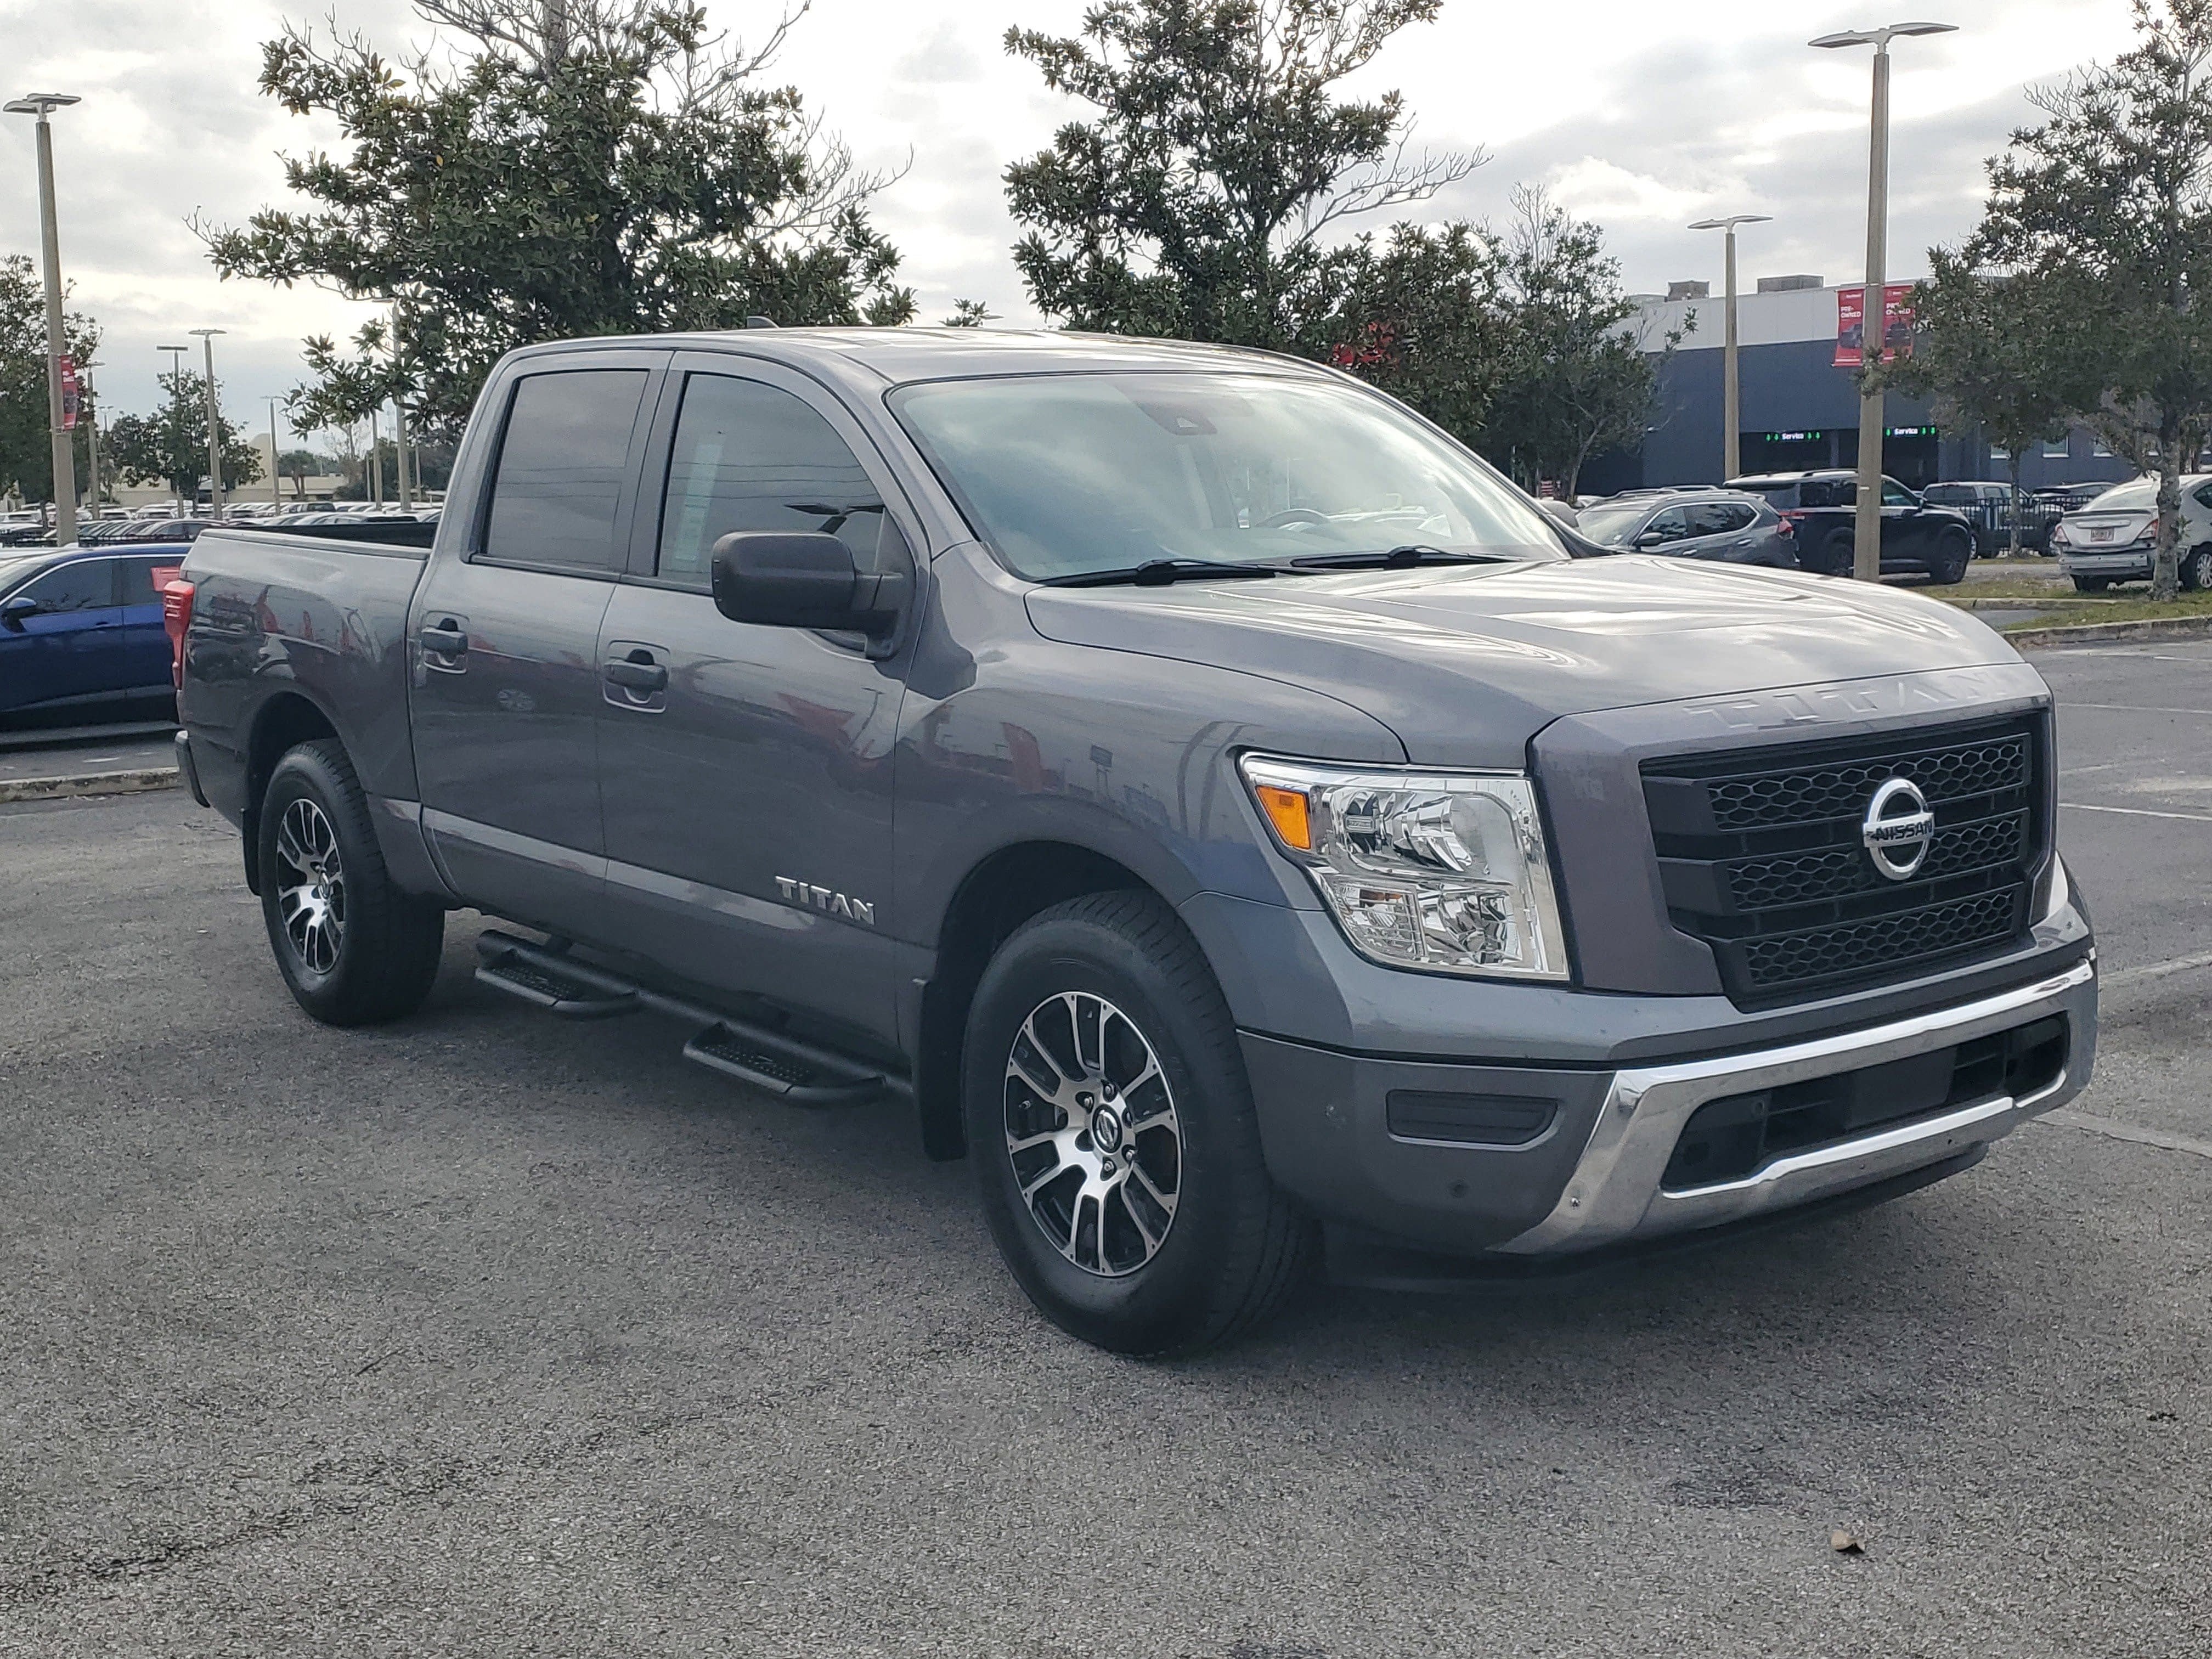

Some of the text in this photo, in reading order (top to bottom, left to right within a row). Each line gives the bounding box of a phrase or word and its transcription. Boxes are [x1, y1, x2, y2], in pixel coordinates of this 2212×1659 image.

[1682, 671, 2008, 729] TITAN
[1867, 820, 1933, 842] NISSAN
[775, 875, 875, 926] TITAN
